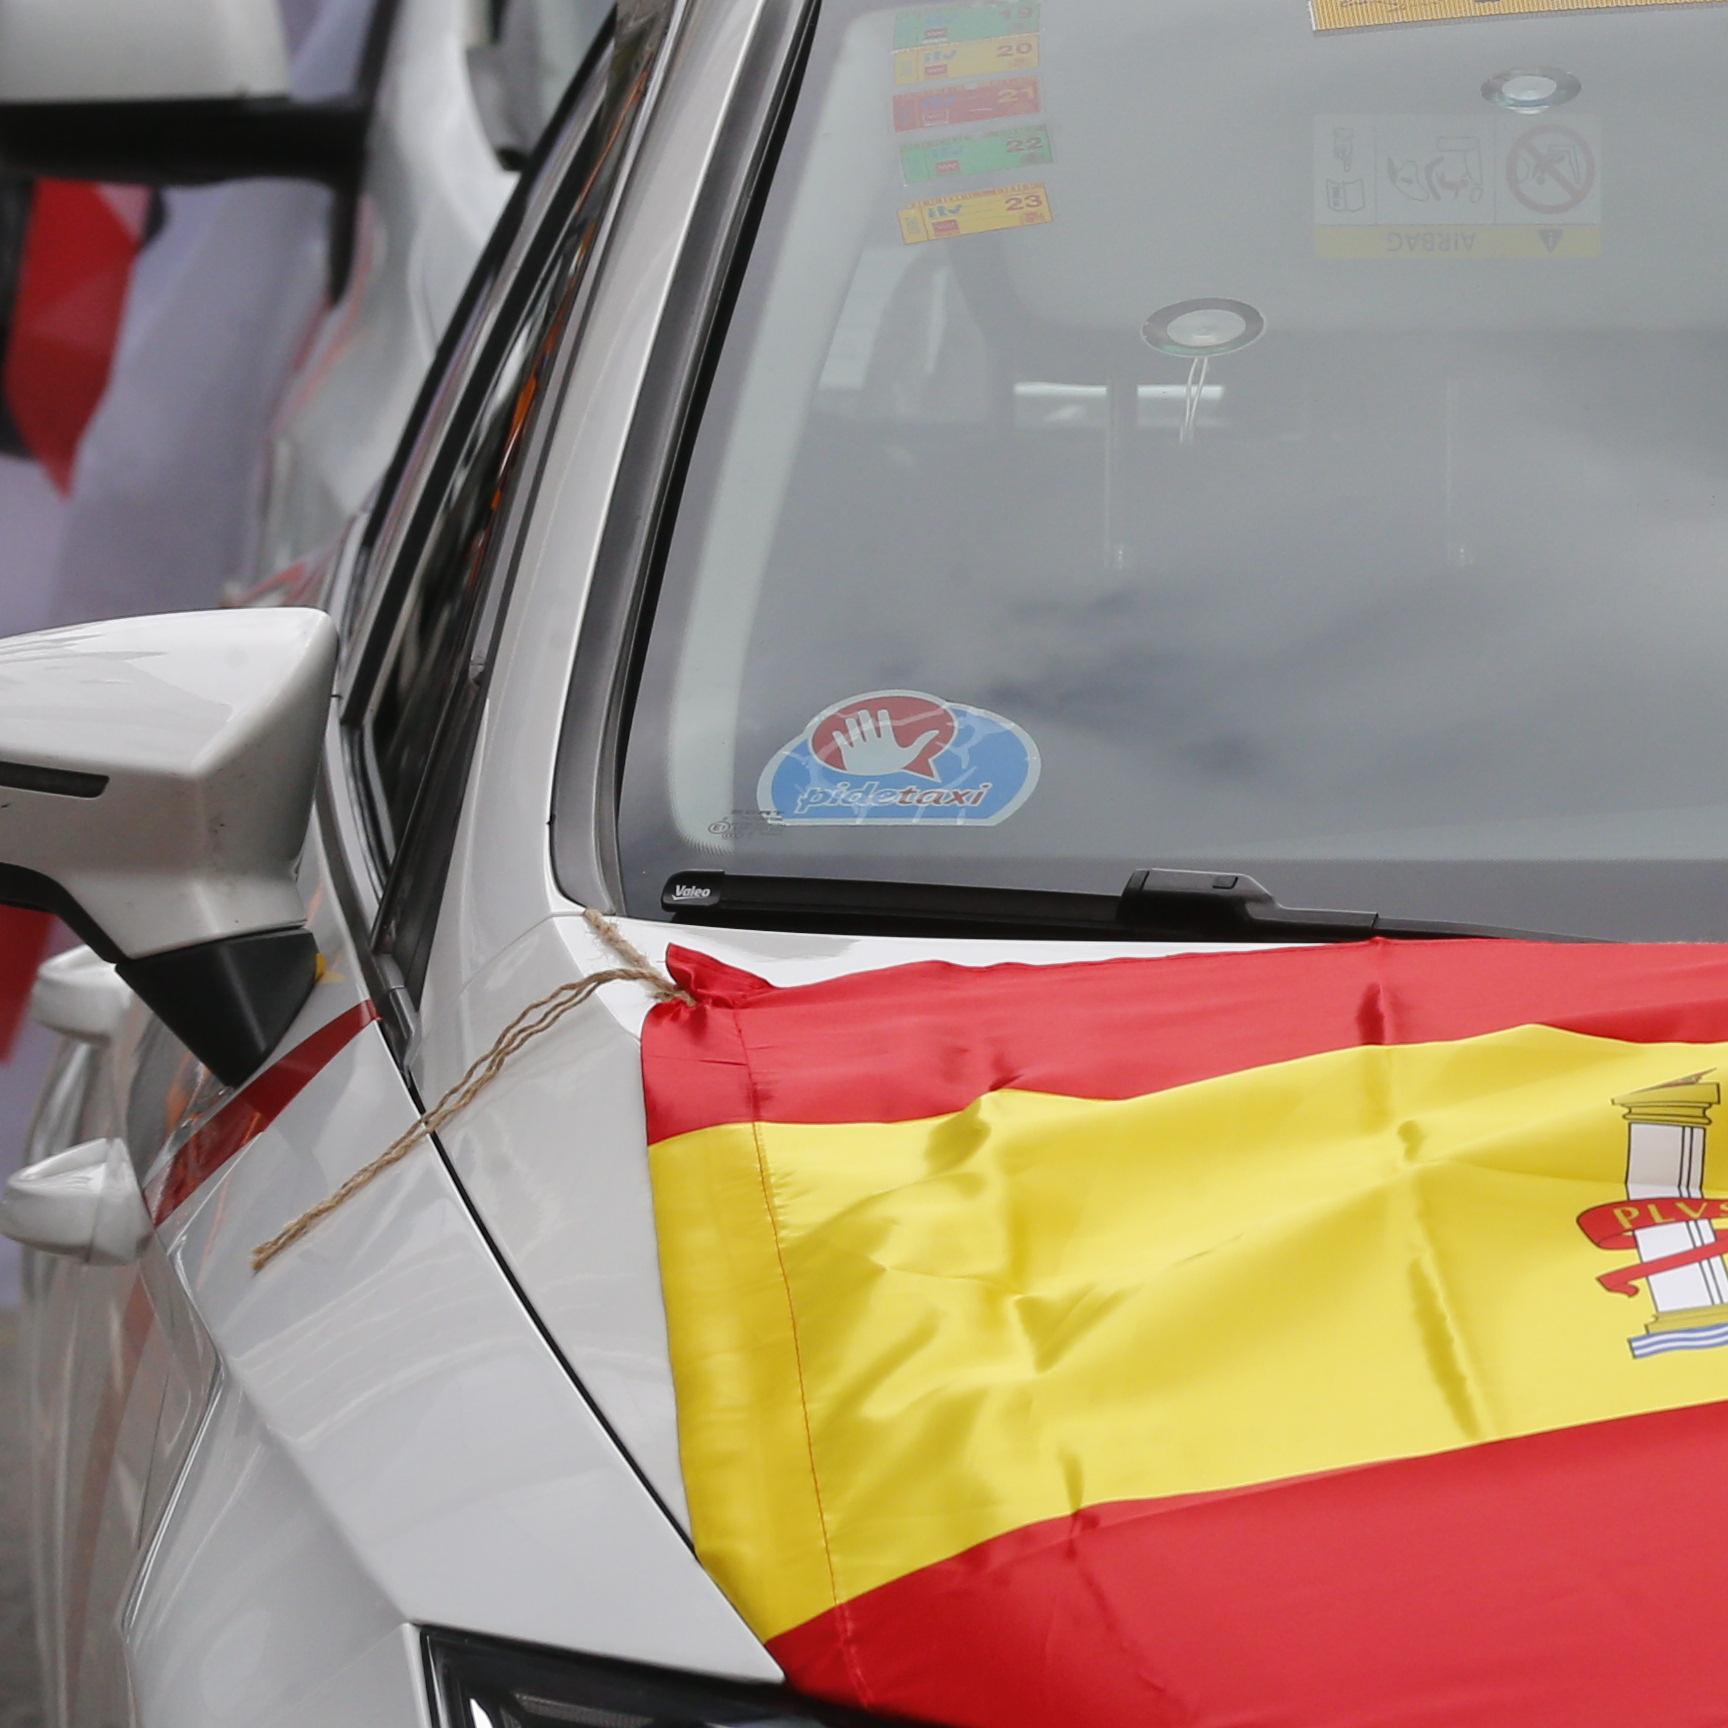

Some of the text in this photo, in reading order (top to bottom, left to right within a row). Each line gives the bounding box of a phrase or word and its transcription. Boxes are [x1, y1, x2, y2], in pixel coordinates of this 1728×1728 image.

[996, 41, 1033, 59] 20
[1005, 136, 1044, 154] 22
[1004, 194, 1043, 212] 23
[1386, 231, 1477, 253] AIRBAG
[794, 780, 993, 814] pidetaxi
